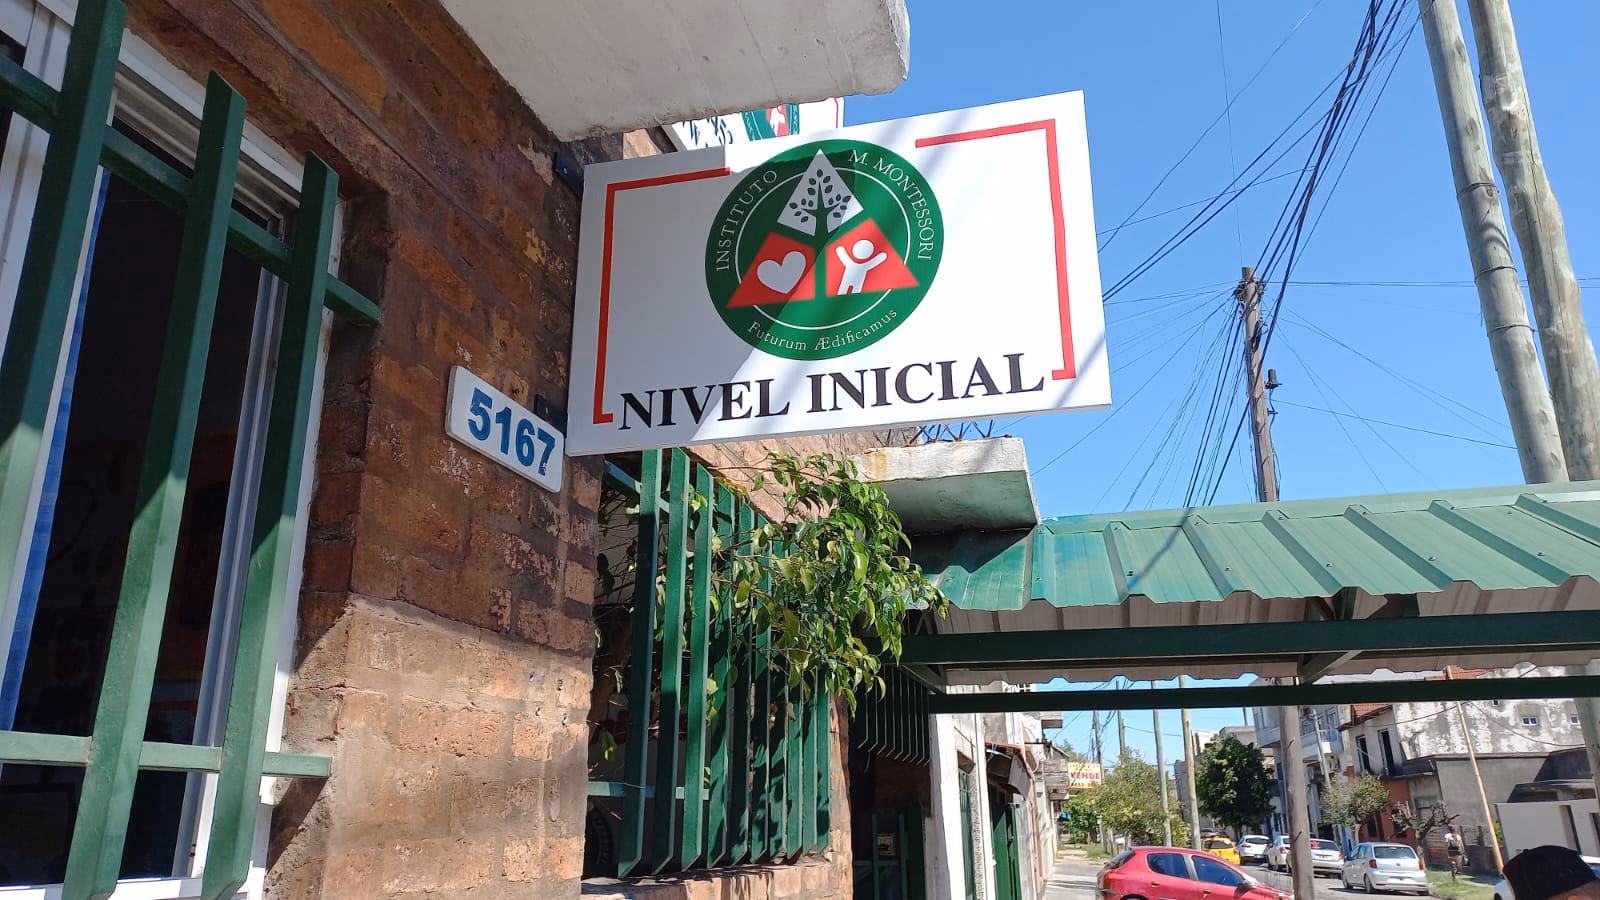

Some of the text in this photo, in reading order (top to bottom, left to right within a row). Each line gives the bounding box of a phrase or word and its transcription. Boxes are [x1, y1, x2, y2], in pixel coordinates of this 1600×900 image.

[716, 149, 935, 272] INSTITUTO M. MONTESSORI
[747, 309, 898, 351] Futurum Ædificamus
[467, 387, 556, 477] 5167
[617, 352, 1044, 430] NIVEL INICIAL
